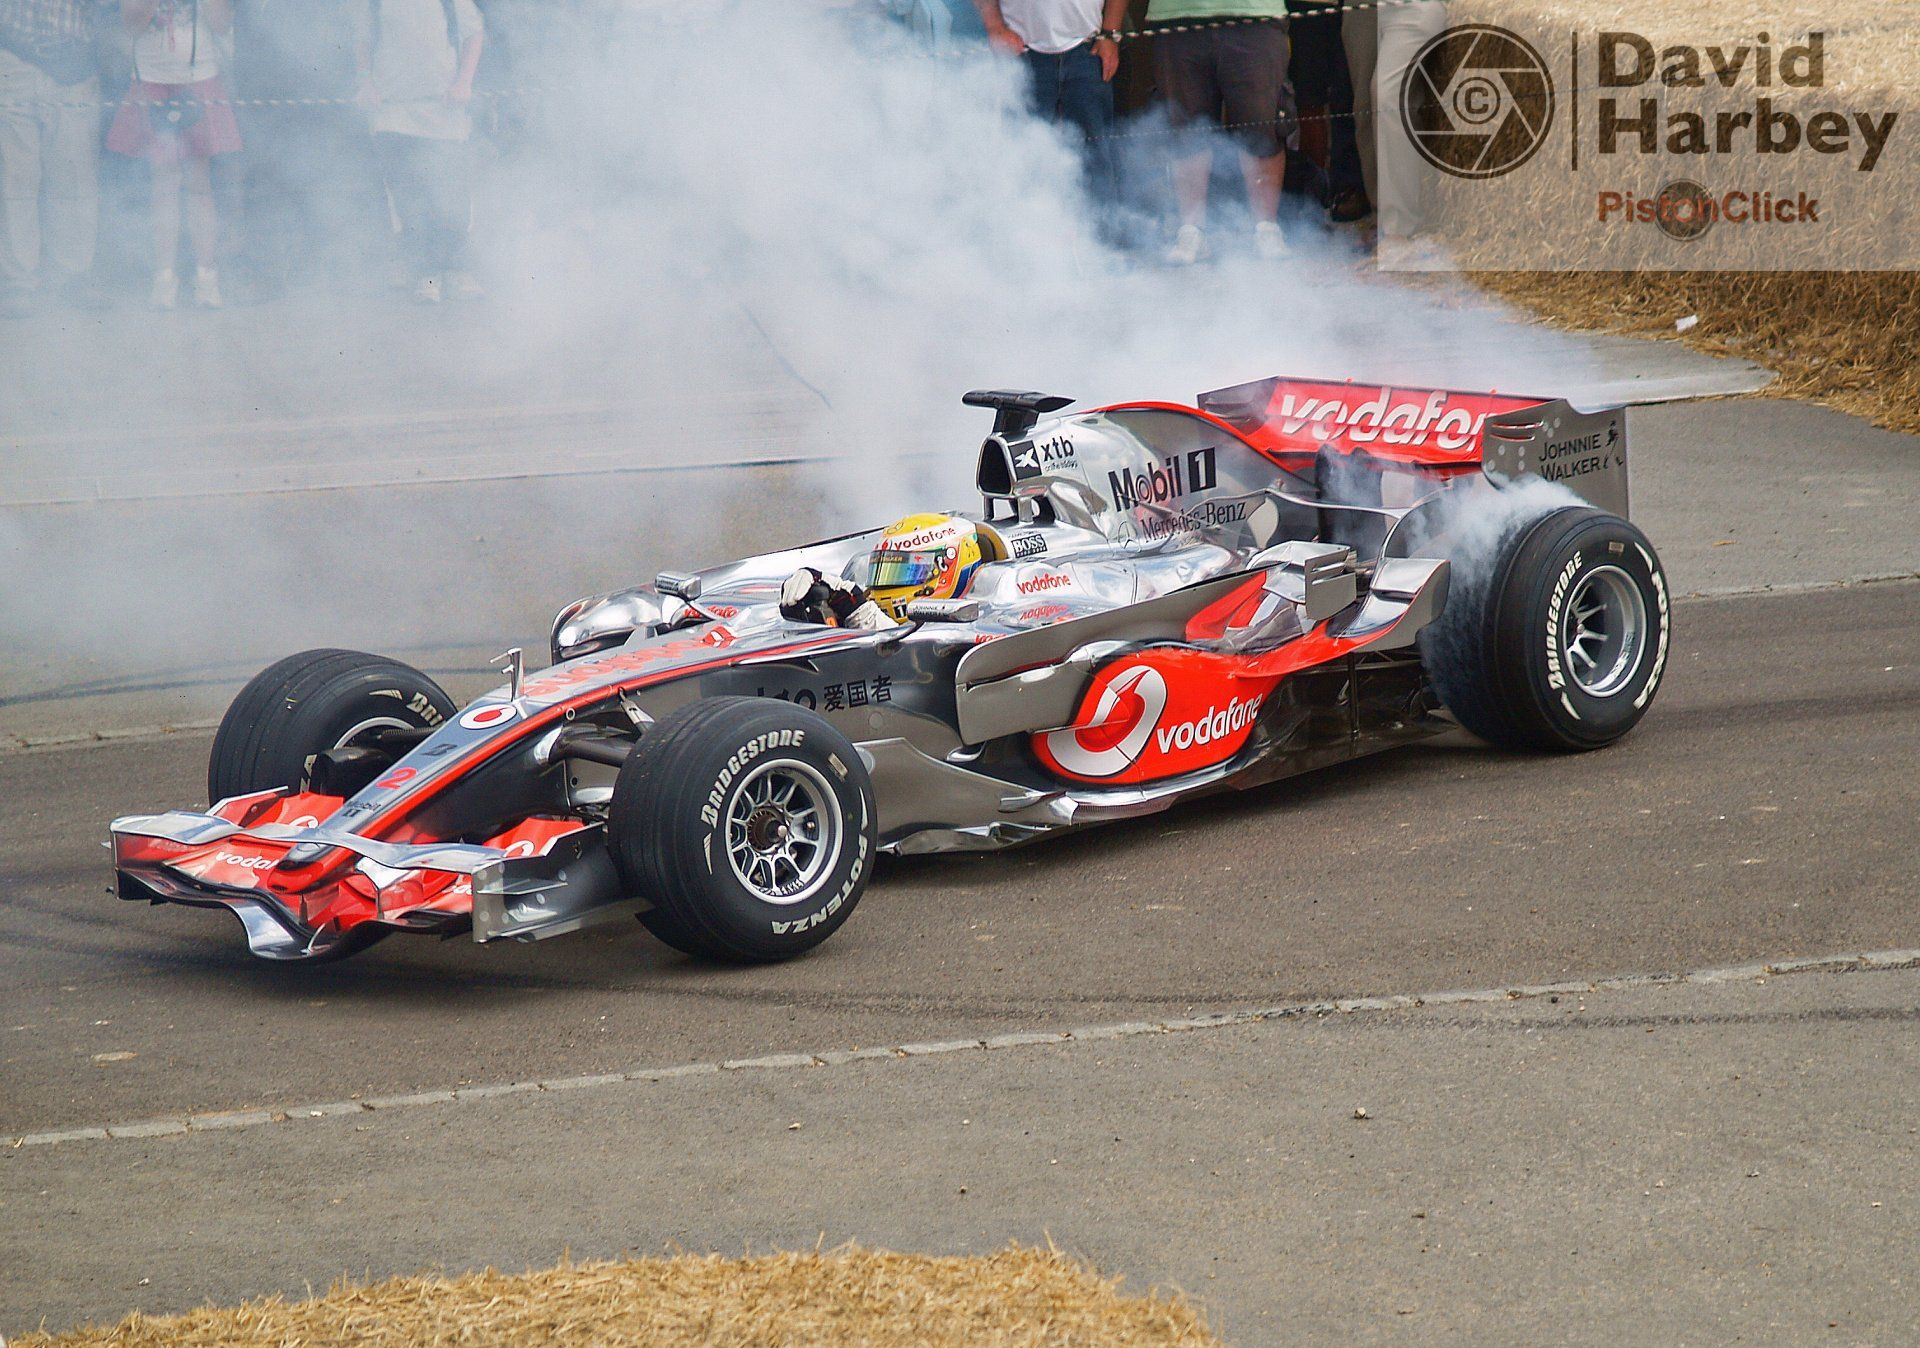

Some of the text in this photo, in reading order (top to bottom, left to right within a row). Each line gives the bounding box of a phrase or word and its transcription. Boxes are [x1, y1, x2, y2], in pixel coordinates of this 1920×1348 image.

[1041, 436, 1074, 461] xtb
[1539, 434, 1601, 461] JOHNNIE
[1108, 455, 1183, 512] Mobil
[1541, 457, 1601, 482] WALKER
[1141, 502, 1247, 543] Mercedes-Benz
[894, 528, 956, 551] vodafone
[1013, 536, 1044, 553] BOSS
[1017, 573, 1071, 594] vodafone
[1546, 551, 1583, 689] BRIDGESTONE
[824, 675, 893, 713] 爱国者
[1157, 693, 1263, 754] vodafone
[375, 767, 417, 790] 2
[701, 729, 804, 829] BRIDGESTONE
[771, 834, 868, 935] POTENZA
